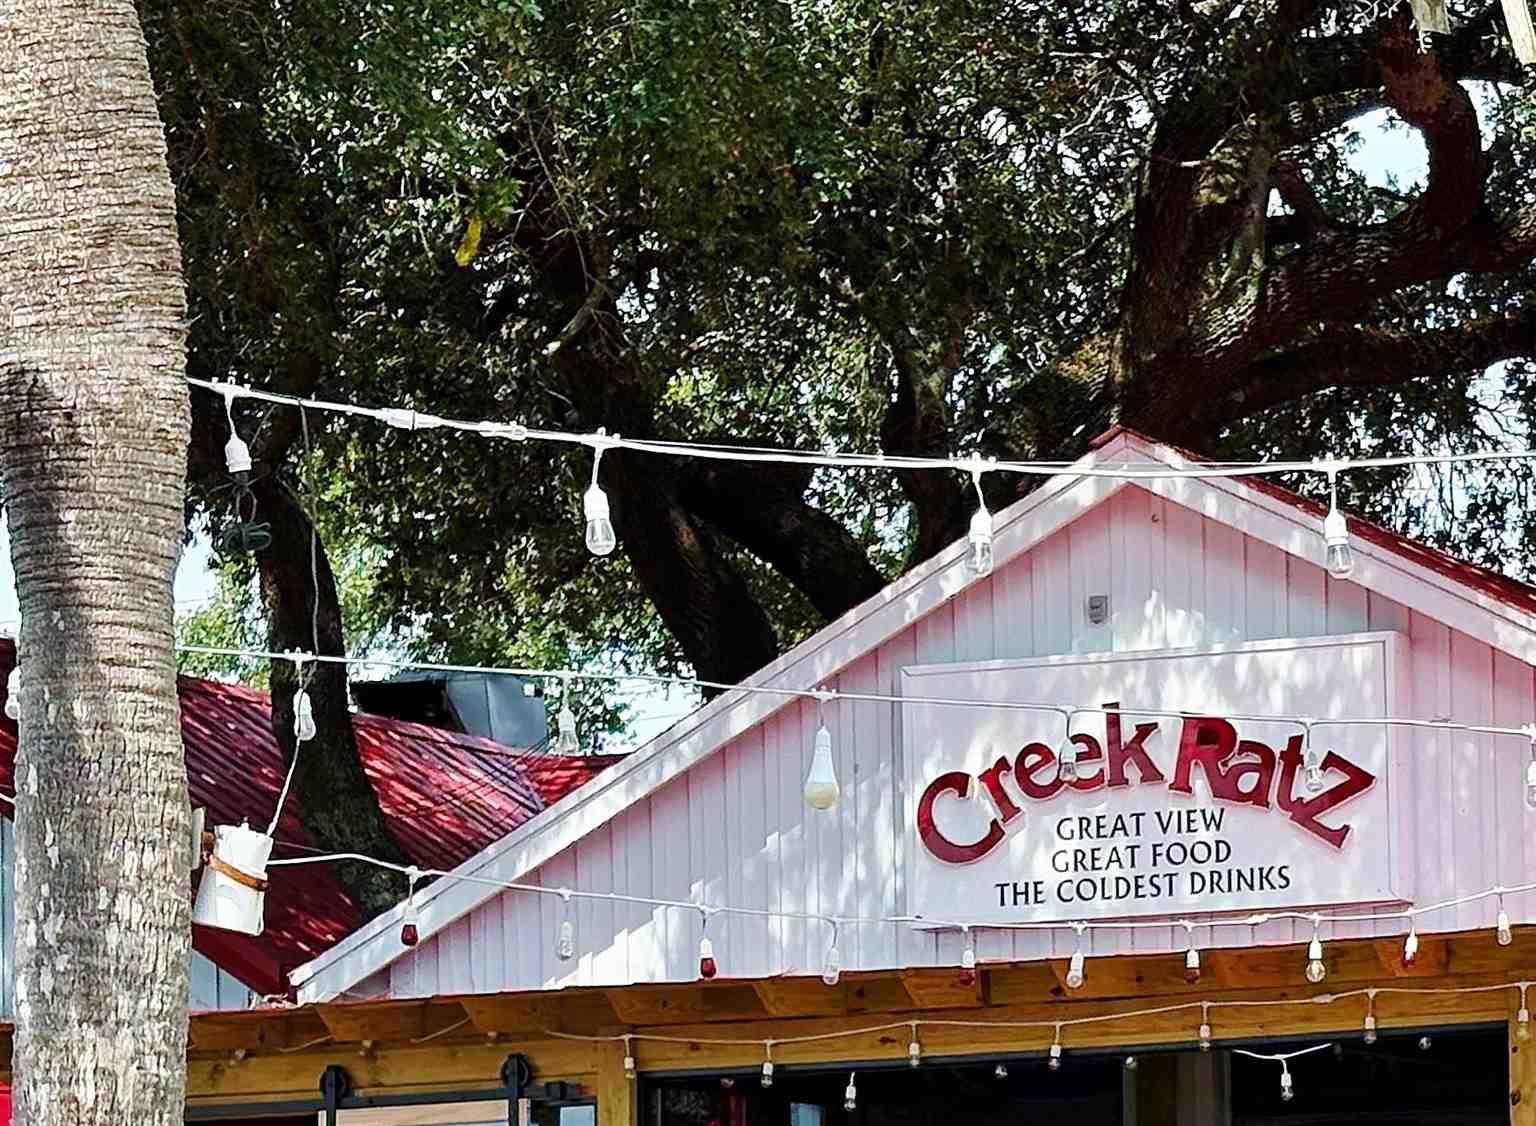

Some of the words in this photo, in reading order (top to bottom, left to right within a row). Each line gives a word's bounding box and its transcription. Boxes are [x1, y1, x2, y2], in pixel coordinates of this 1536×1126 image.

[917, 701, 1164, 864] Creek
[1168, 711, 1376, 849] Ratz
[1056, 812, 1146, 840] GREAT
[1154, 808, 1225, 834] VIEW
[1051, 845, 1141, 873] GREAT
[1151, 840, 1232, 866] FOOD
[995, 881, 1045, 907] THE
[1056, 872, 1179, 902] COLDEST
[1190, 865, 1291, 895] DRINKS
